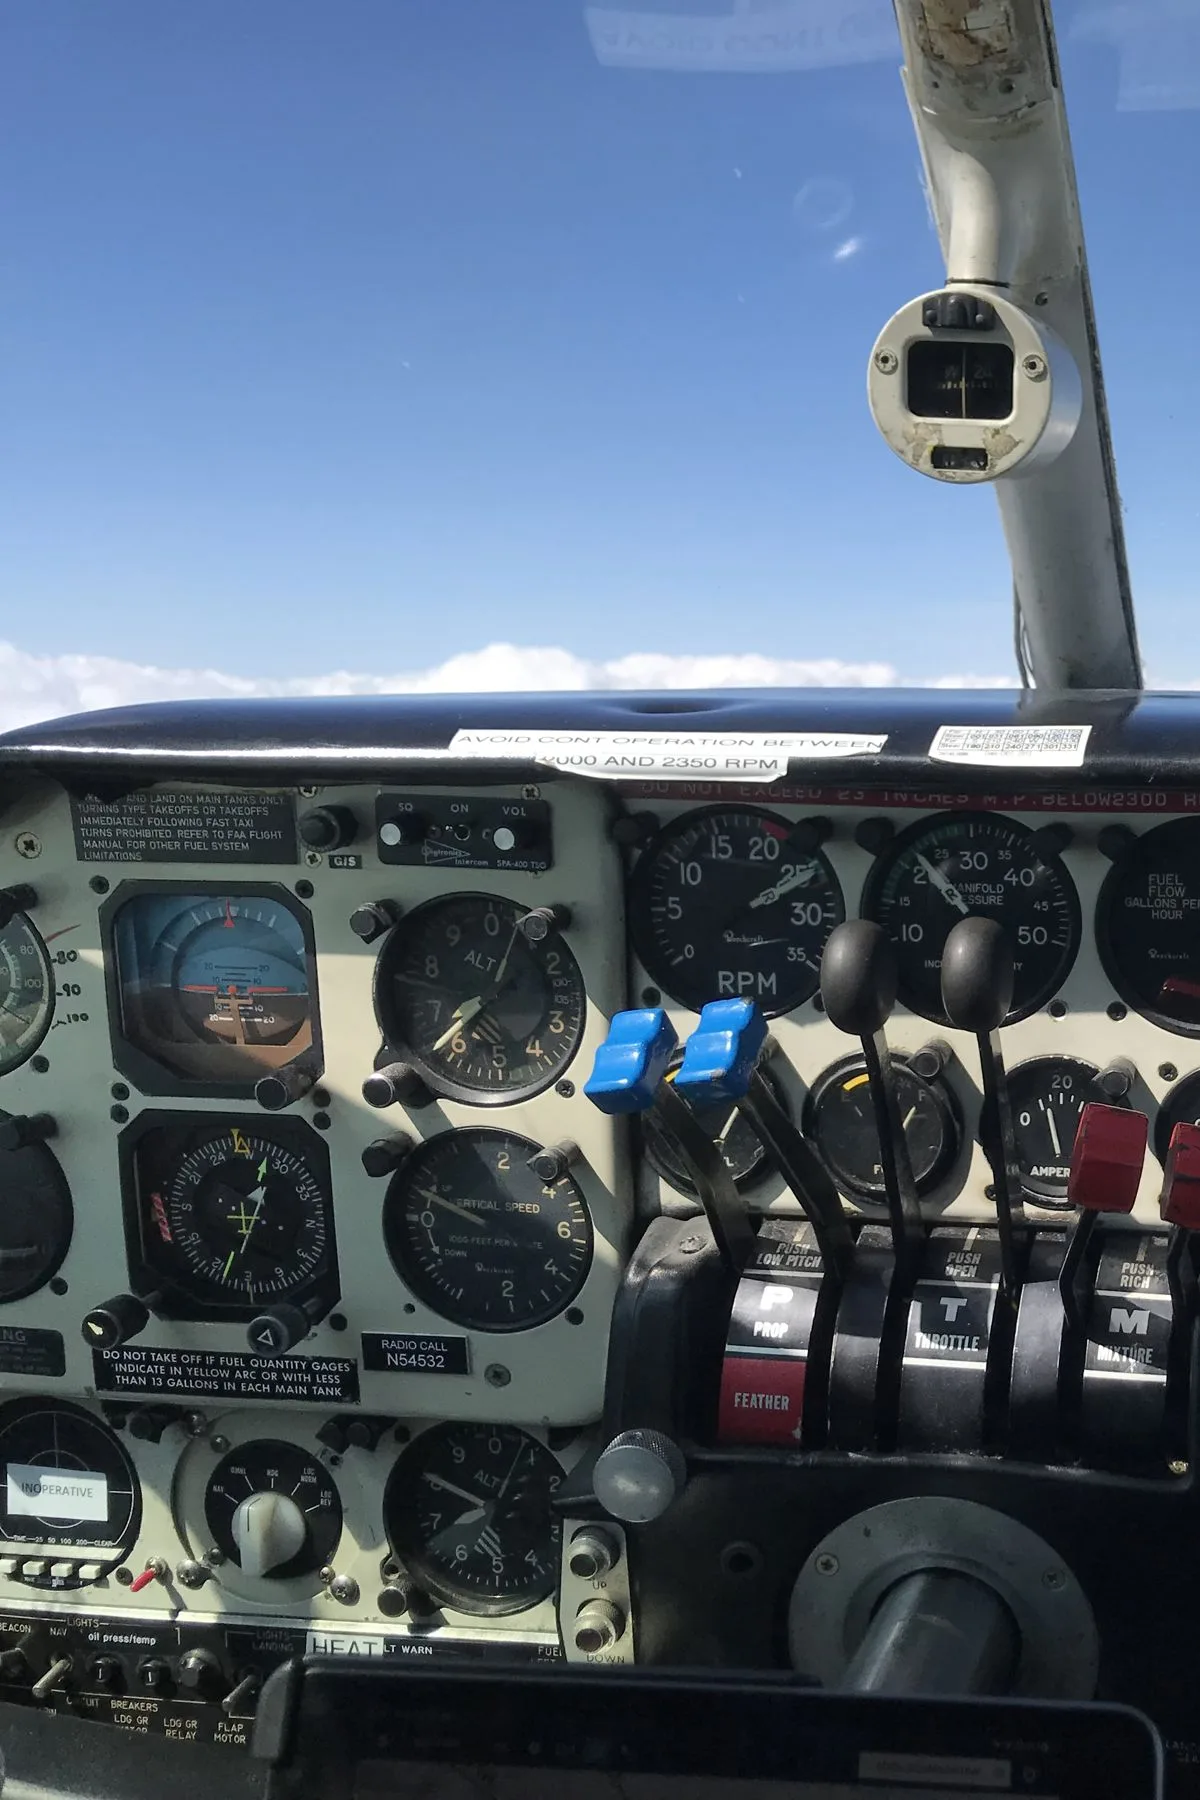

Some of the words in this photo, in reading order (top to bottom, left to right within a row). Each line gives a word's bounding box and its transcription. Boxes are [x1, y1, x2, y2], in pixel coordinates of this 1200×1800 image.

[538, 736, 601, 744] CONT
[612, 736, 754, 747] OPERATION
[763, 740, 882, 749] BETWEEN
[605, 756, 656, 767] AND
[662, 757, 717, 769] 2350
[726, 757, 778, 770] RPM
[150, 794, 175, 803] LAND
[197, 795, 221, 803] MAIN
[225, 795, 256, 804] TANKS
[123, 804, 147, 814] TYPE
[150, 805, 199, 814] TAKEOFFS
[220, 806, 268, 816] TAKEOFFS
[450, 804, 469, 812] ON
[502, 806, 526, 816] VOL
[80, 817, 144, 825] IMMEDIATELY
[148, 817, 202, 826] FOLLOWING
[206, 818, 230, 827] FAST
[234, 819, 253, 827] TAXI
[80, 829, 112, 837] TURNS
[116, 829, 171, 838] PROHIBITED
[177, 830, 208, 839] REFER
[213, 830, 224, 839] TO
[228, 831, 245, 839] FAA
[250, 831, 283, 839] FLIGHT
[84, 841, 123, 849] MANUAL
[127, 841, 146, 849] FOR
[150, 841, 180, 850] OTHER
[184, 842, 208, 850] FUEL
[211, 842, 249, 851] SYSTEM
[711, 836, 733, 859] 15
[749, 837, 779, 860] 20
[84, 852, 142, 861] LIMITATIONS
[959, 852, 988, 870] 30
[680, 862, 702, 885] 10
[1004, 868, 1035, 887] 40
[1148, 874, 1183, 884] FUEL
[1149, 886, 1186, 898] FLOW
[1125, 899, 1177, 909] GALLONS
[790, 903, 822, 925] 30
[1152, 910, 1183, 920] HOUR
[902, 924, 923, 942] 10
[1018, 927, 1047, 945] 50
[787, 948, 806, 961] 35
[718, 971, 777, 994] RPM
[1052, 1076, 1072, 1088] 20
[505, 1203, 540, 1214] SPEED
[757, 1254, 782, 1265] LOW
[786, 1255, 822, 1267] PITCH
[947, 1252, 981, 1264] PUSH
[1120, 1275, 1150, 1288] RICH
[753, 1322, 788, 1338] PROP
[382, 1339, 417, 1350] RADIO
[420, 1341, 447, 1351] CALL
[915, 1332, 980, 1351] THROTTLE
[104, 1350, 119, 1359] DO
[123, 1352, 146, 1361] NOT
[151, 1353, 177, 1363] TAKE
[182, 1354, 202, 1364] OFF
[206, 1356, 215, 1364] IF
[220, 1357, 248, 1367] FUEL
[251, 1359, 307, 1369] QUANTITY
[312, 1362, 349, 1372] GAGES
[387, 1353, 445, 1368] N54532
[115, 1363, 165, 1375] INDICATE
[170, 1367, 182, 1375] IN
[186, 1368, 230, 1378] YELLOW
[235, 1370, 257, 1379] ARC
[262, 1372, 277, 1381] OR
[282, 1373, 311, 1382] WITH
[316, 1374, 340, 1384] LESS
[116, 1375, 146, 1385] THAN
[152, 1377, 162, 1386] 13
[167, 1378, 219, 1390] GALLONS
[224, 1382, 236, 1391] IN
[241, 1383, 270, 1393] EACH
[275, 1385, 307, 1395] MAIN
[312, 1386, 341, 1396] TANK
[734, 1393, 789, 1410] FEATHER
[22, 1482, 93, 1498] INOPERATIVE
[88, 1633, 100, 1641] oil
[103, 1634, 156, 1645] press/temp
[401, 1645, 433, 1654] WARN
[111, 1701, 158, 1712] BREAKERS
[114, 1714, 132, 1724] LDG
[164, 1718, 181, 1728] LDG
[218, 1722, 243, 1731] FLAP
[214, 1734, 245, 1744] MOTOR
